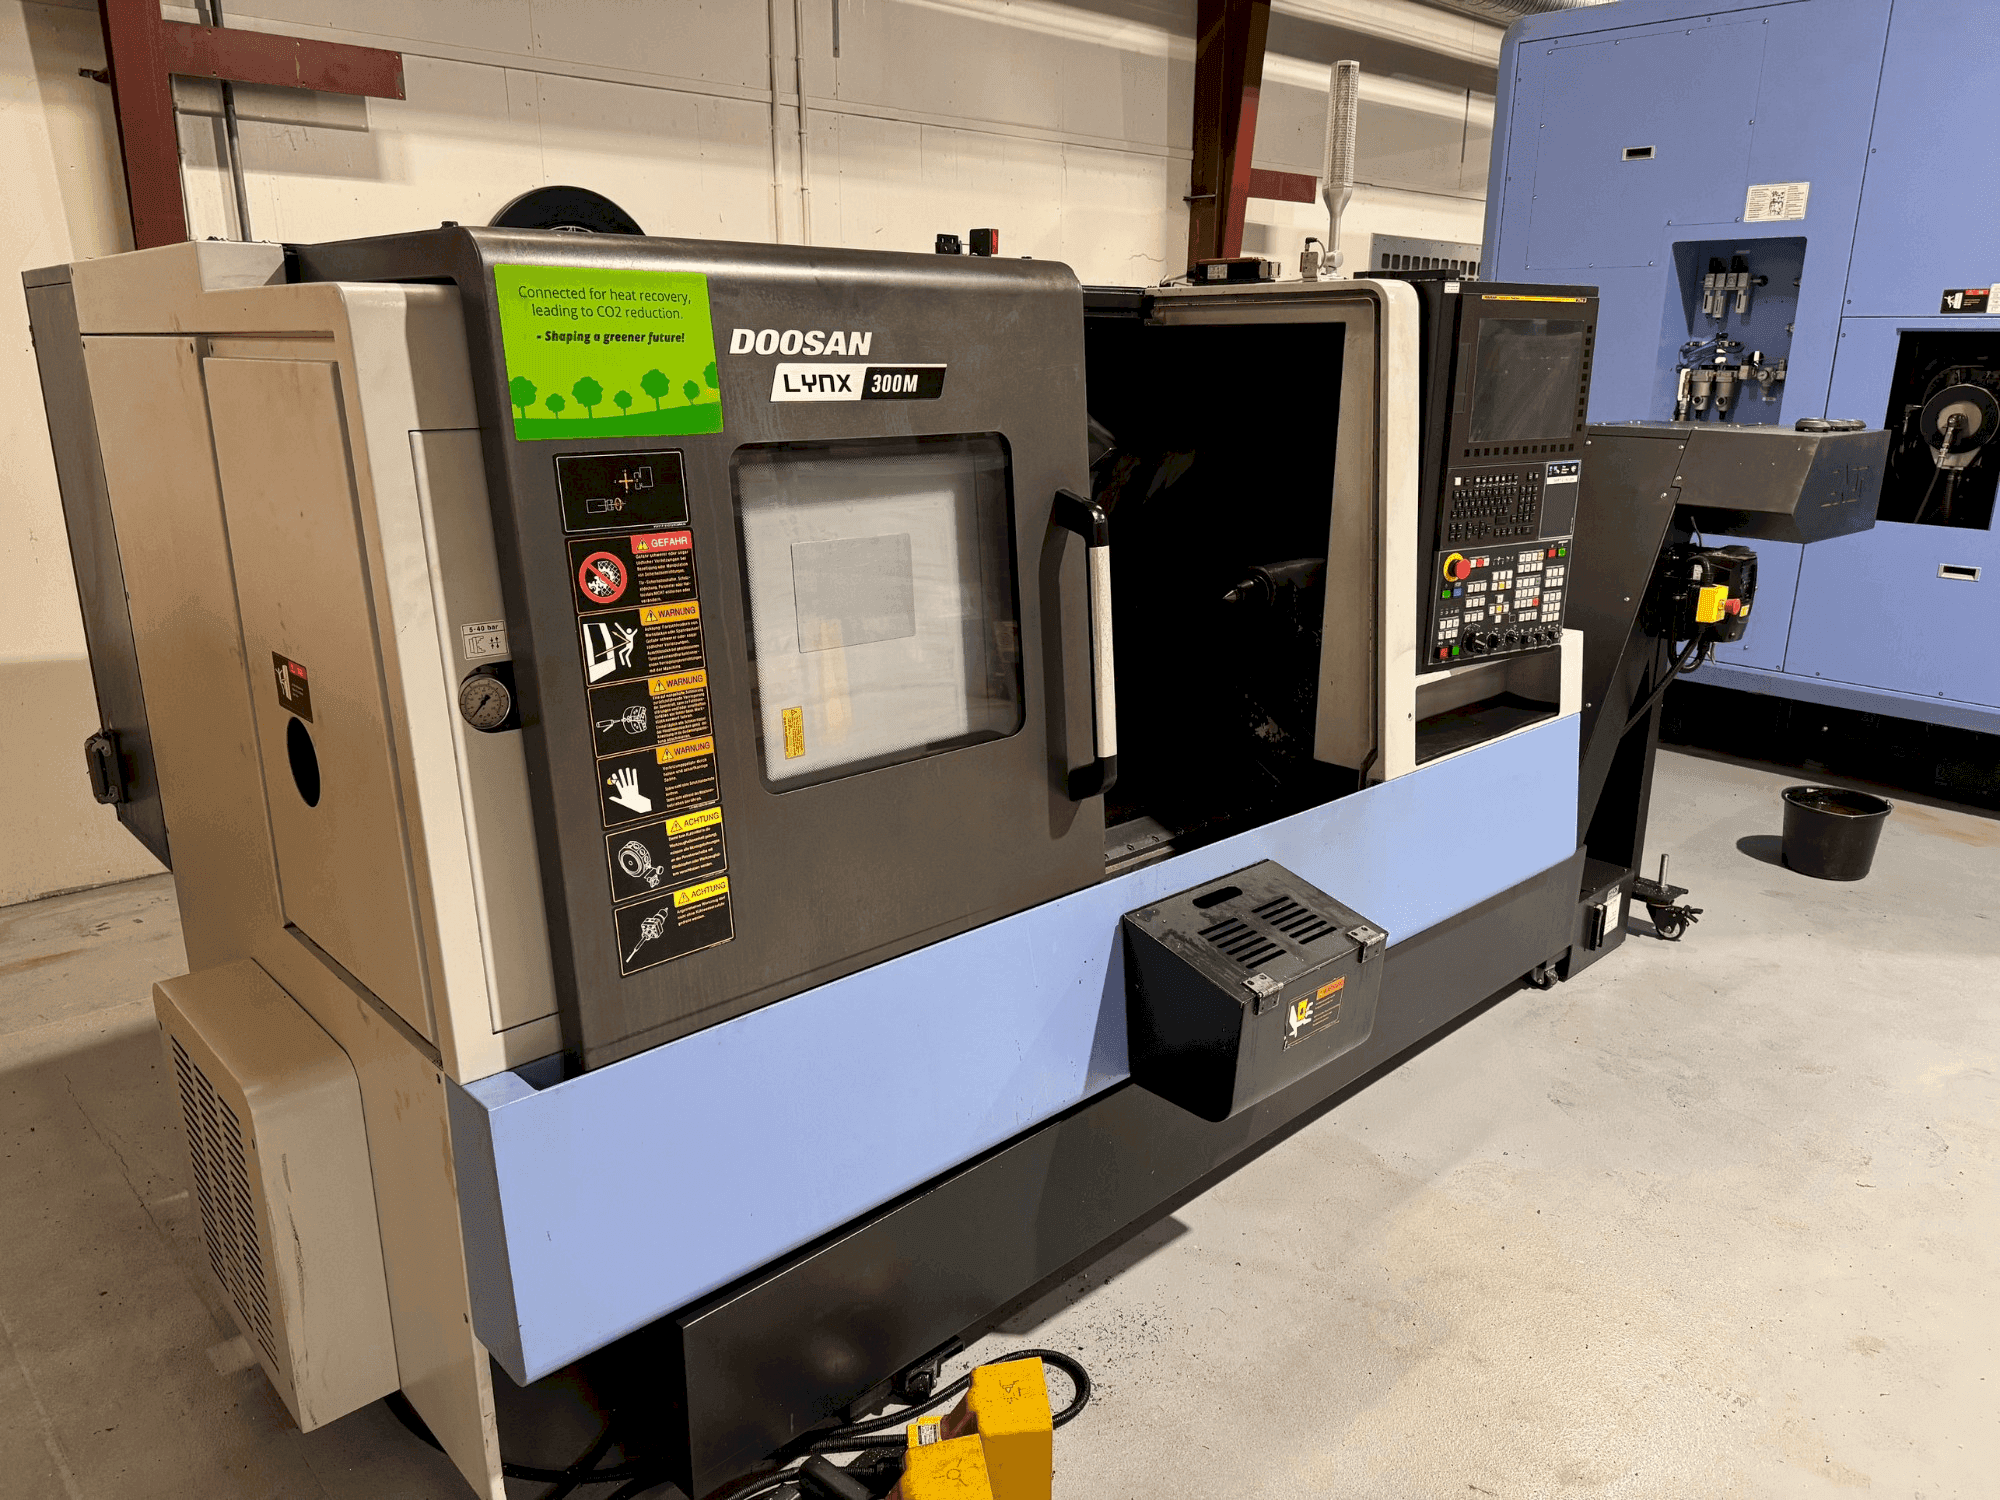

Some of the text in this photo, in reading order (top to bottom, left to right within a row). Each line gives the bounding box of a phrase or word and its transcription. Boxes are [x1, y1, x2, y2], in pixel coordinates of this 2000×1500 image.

[518, 285, 691, 306] Connected for heat recovery,
[532, 303, 684, 321] leading to CO2 reduction.
[544, 330, 591, 345] Shaping
[594, 333, 600, 342] a
[603, 332, 646, 345] greener
[647, 331, 685, 346] future!
[729, 328, 873, 356] DOOSAN
[871, 374, 919, 393] 300M
[651, 536, 688, 548] GEFAHR
[658, 606, 696, 618] WARNUNG
[666, 674, 704, 687] WARNUNG
[674, 741, 711, 755] WARNUNG
[684, 811, 720, 827] ACHTUNG
[691, 881, 726, 898] ACHTUNG
